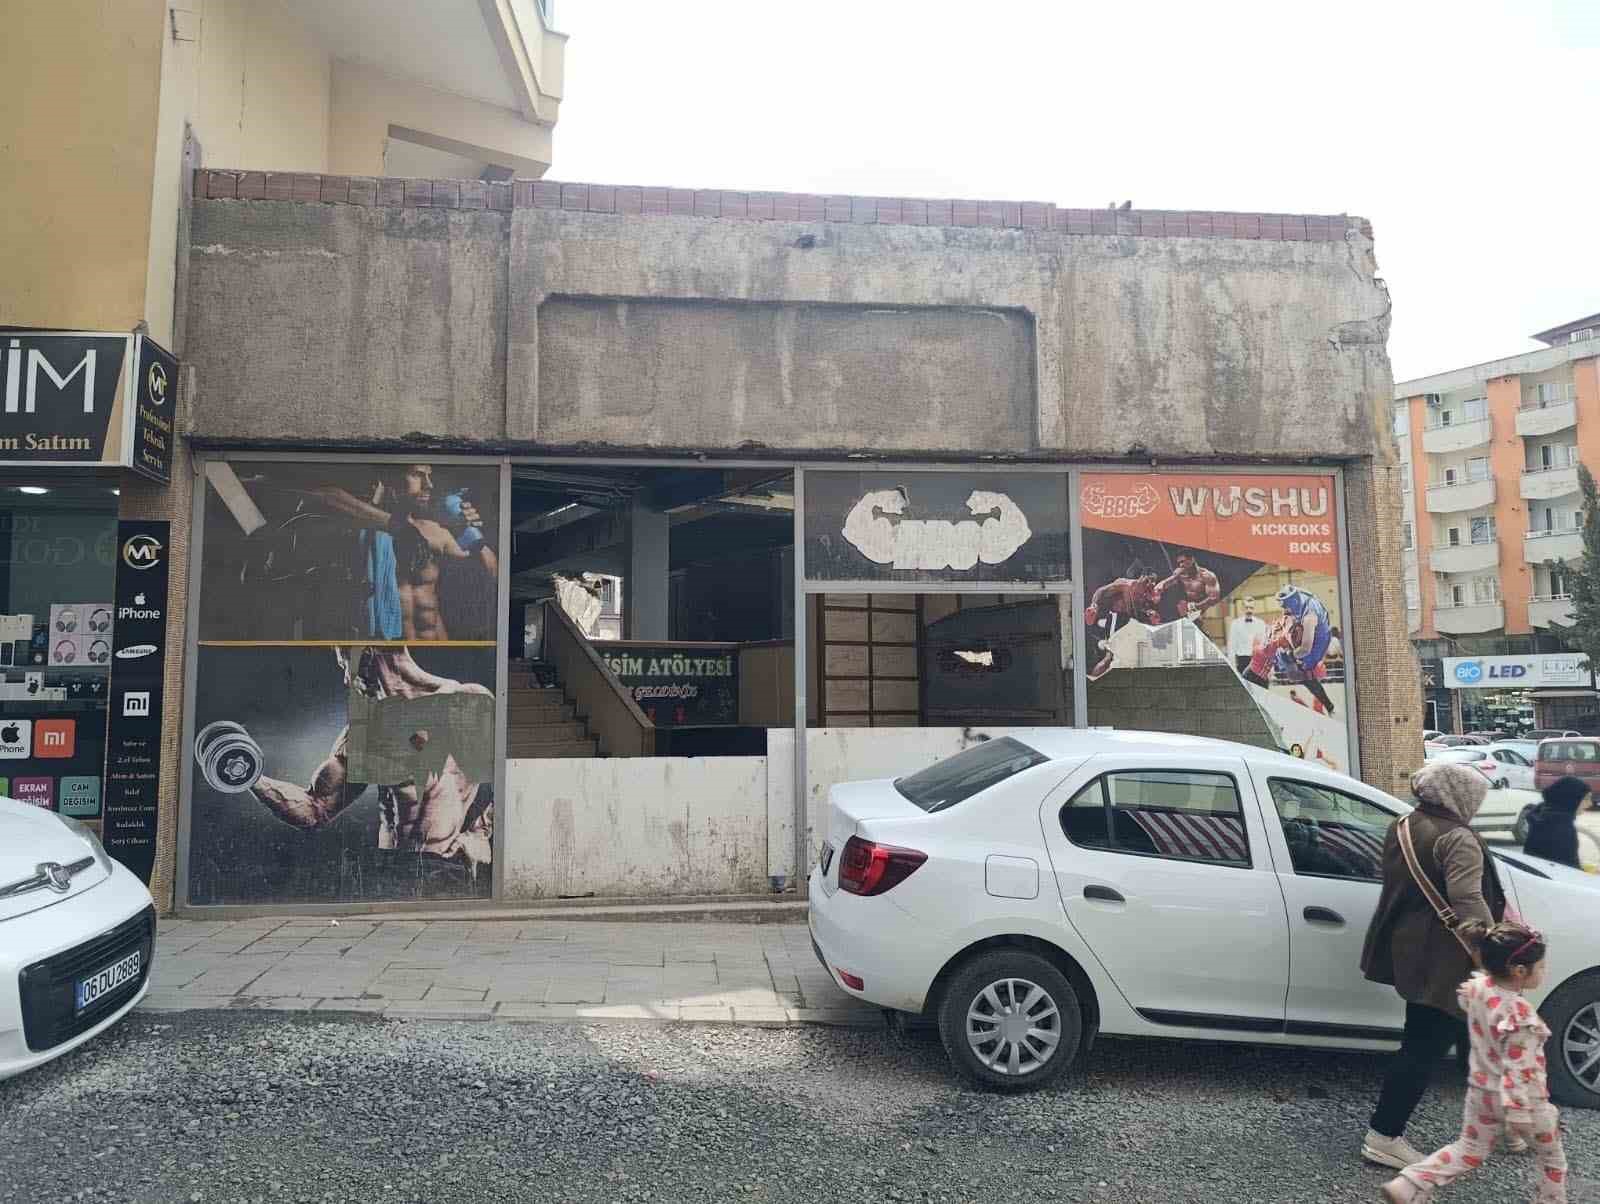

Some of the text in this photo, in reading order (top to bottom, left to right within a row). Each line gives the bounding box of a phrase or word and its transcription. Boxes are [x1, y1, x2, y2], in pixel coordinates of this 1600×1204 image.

[0, 339, 97, 413] İM
[25, 433, 90, 450] Satım
[1168, 486, 1329, 517] WUSHU
[1289, 542, 1333, 554] BOKS
[118, 607, 161, 620] iPhone
[648, 653, 734, 676] ATÖLYESİ
[1488, 664, 1527, 679] LED
[19, 783, 47, 793] EKRAN
[83, 953, 140, 1002] 06 DU 2889
